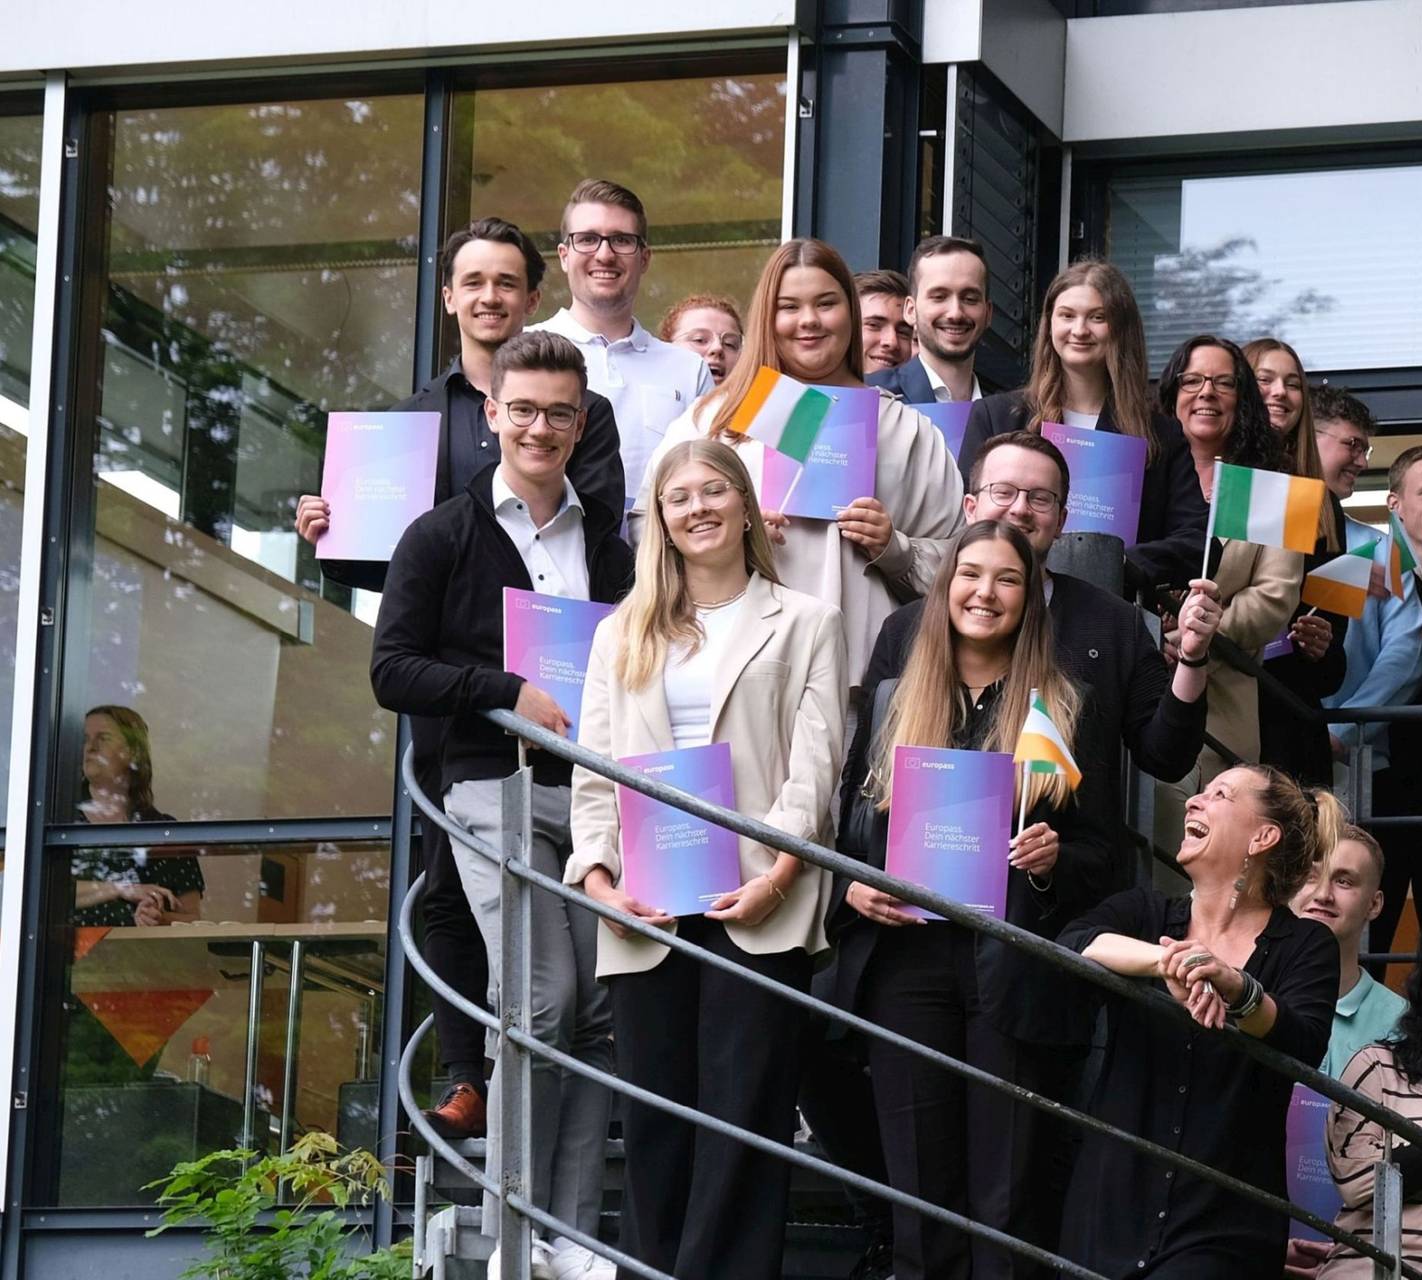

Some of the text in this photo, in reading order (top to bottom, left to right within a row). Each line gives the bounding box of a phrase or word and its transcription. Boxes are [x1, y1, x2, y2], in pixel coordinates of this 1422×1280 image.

[532, 603, 562, 614] europass
[539, 673, 585, 685] Karriereschr
[643, 764, 675, 774] europass
[921, 761, 956, 771] europass
[925, 822, 964, 834] Europass.
[656, 832, 674, 843] Dein
[656, 837, 709, 850] Karriereschritt
[924, 832, 981, 844] Dein nächster
[923, 840, 981, 853] Karriereschritt
